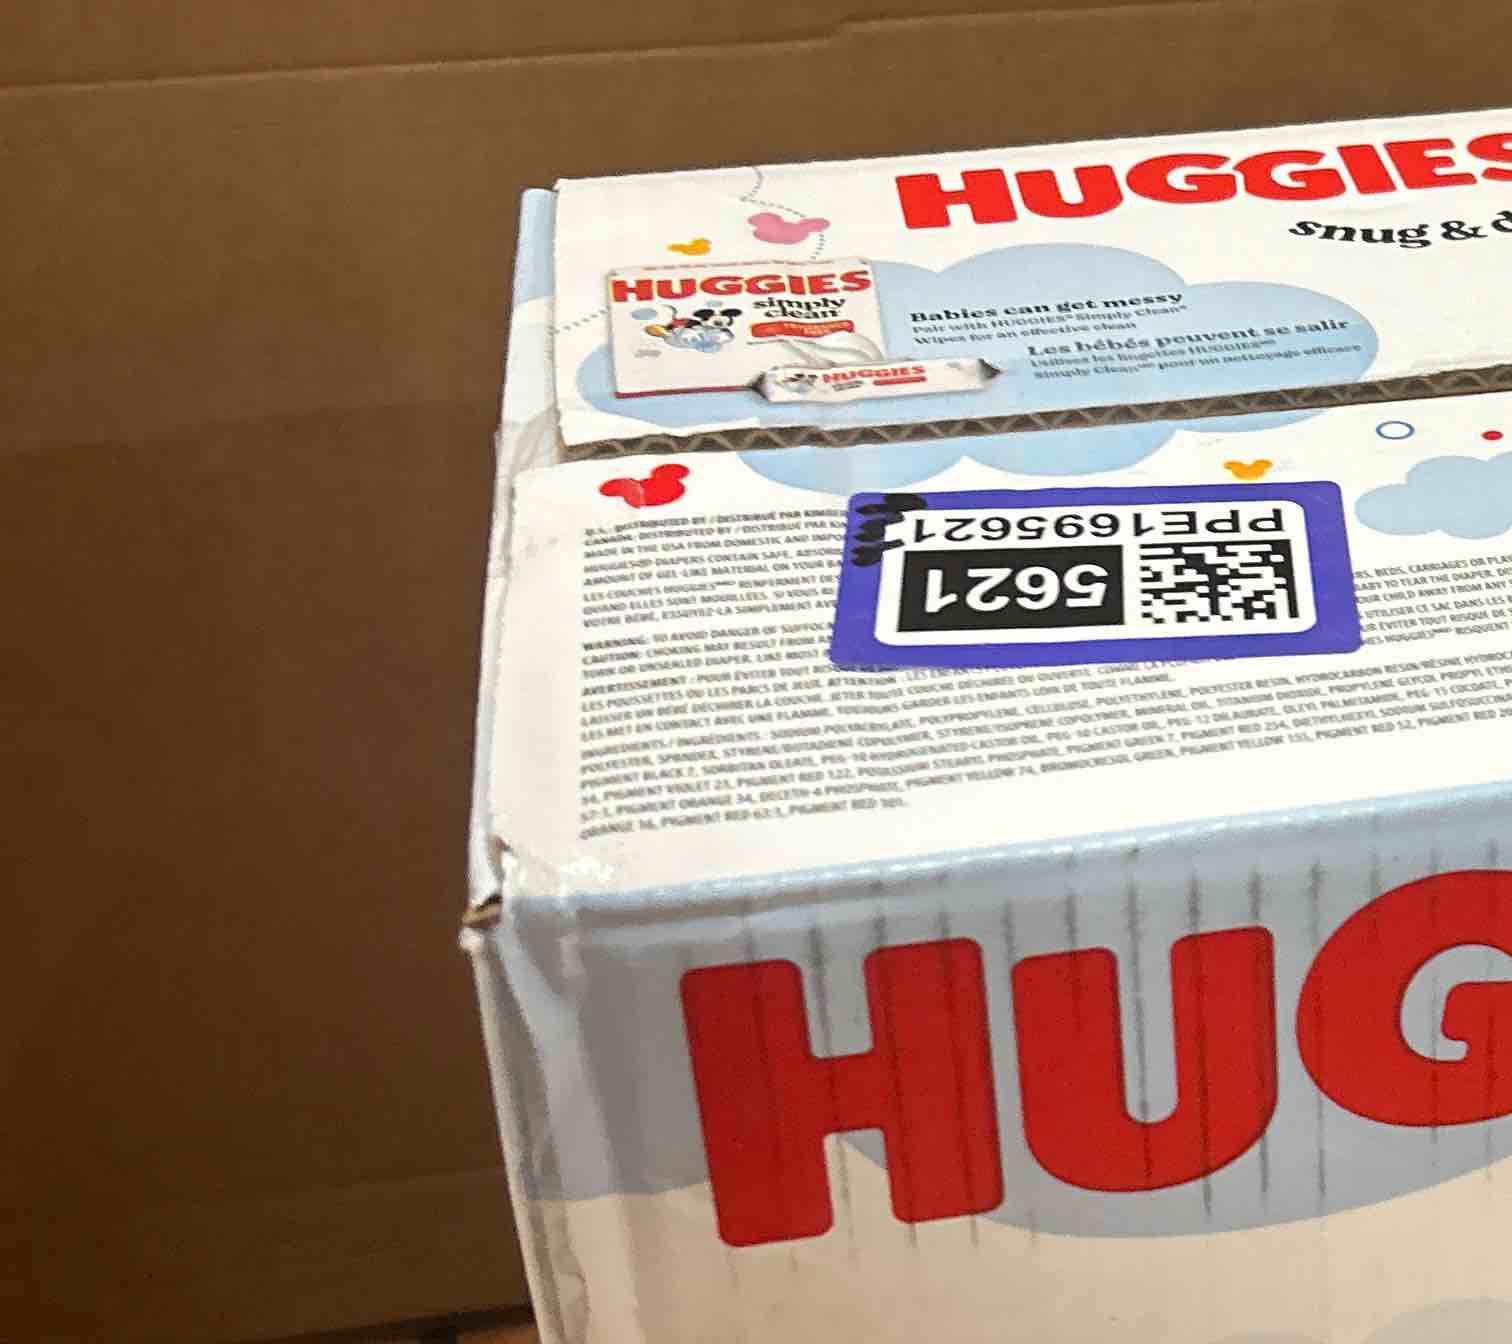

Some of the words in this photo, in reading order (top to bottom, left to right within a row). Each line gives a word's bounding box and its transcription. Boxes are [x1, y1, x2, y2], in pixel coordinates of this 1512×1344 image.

[1288, 219, 1431, 250] snug
[1439, 220, 1486, 242] &
[611, 270, 872, 302] HUGGIES
[753, 297, 845, 312] simply
[764, 307, 841, 320] clean
[910, 308, 998, 323] Babies
[1003, 303, 1050, 316] can
[1055, 299, 1098, 313] get
[1102, 293, 1183, 309] messy
[1027, 344, 1071, 357] Les
[1077, 337, 1150, 353] bébés
[1155, 327, 1261, 349] peuvent
[1264, 325, 1290, 336] se
[1295, 319, 1349, 333] salir
[821, 365, 926, 383] HUGGIES
[924, 563, 1109, 613] 5621
